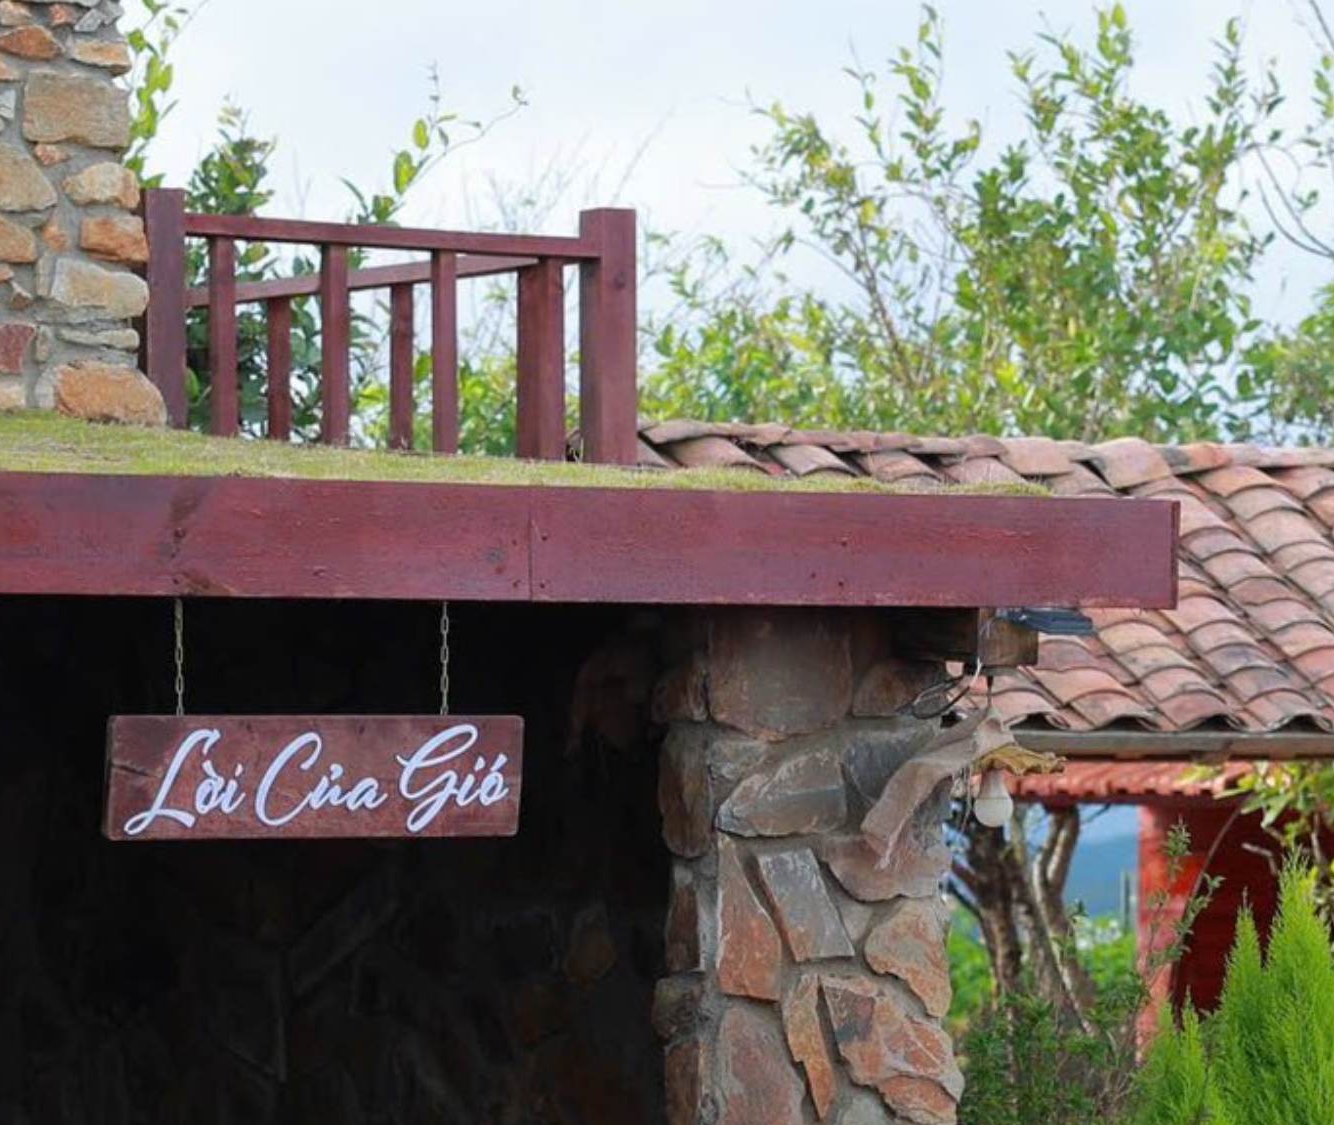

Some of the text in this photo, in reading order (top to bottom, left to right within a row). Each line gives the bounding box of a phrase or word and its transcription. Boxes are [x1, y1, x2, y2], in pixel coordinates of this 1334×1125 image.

[123, 723, 509, 835] Lời Của Gió
